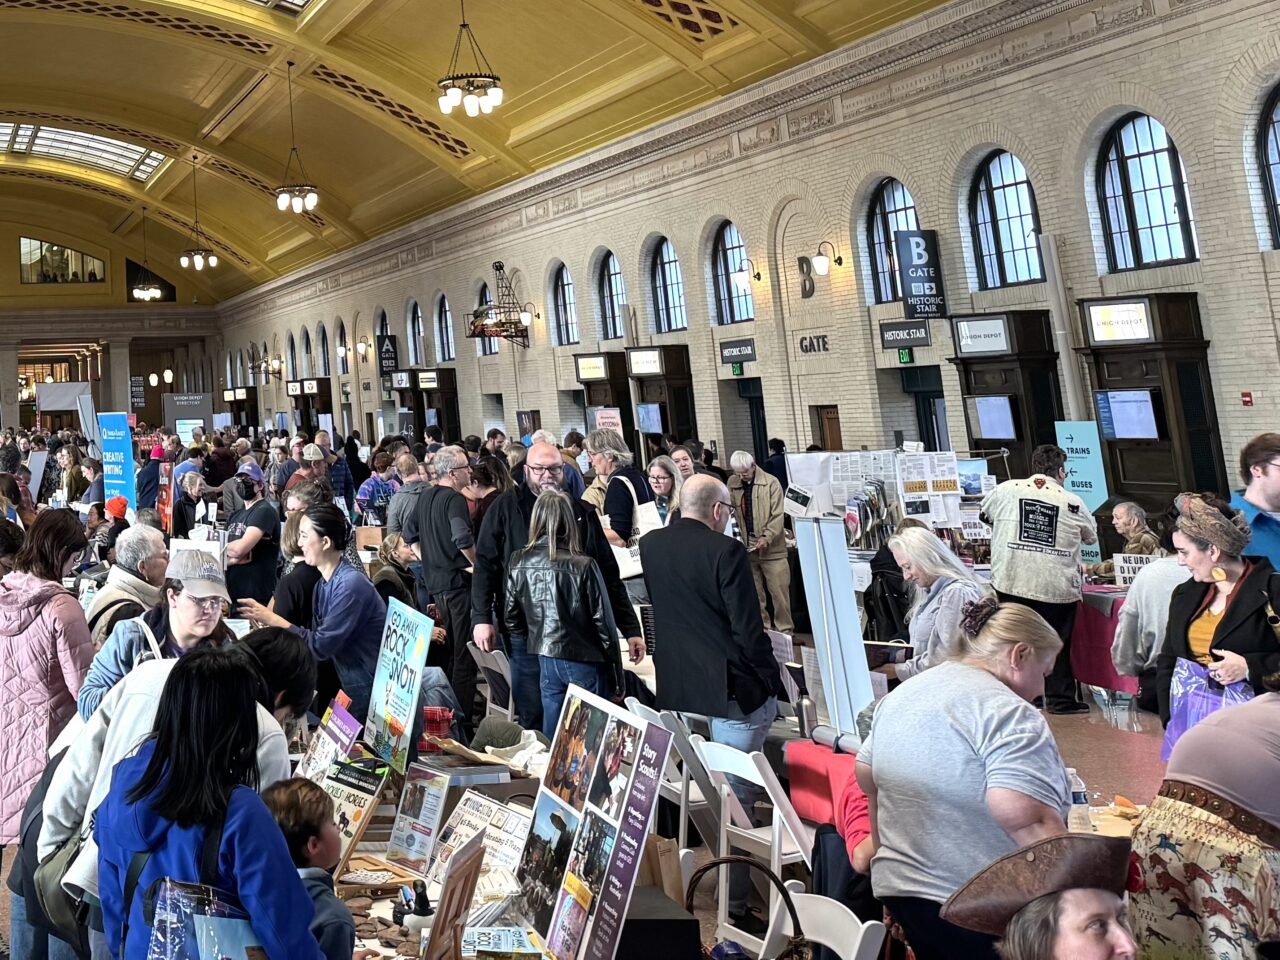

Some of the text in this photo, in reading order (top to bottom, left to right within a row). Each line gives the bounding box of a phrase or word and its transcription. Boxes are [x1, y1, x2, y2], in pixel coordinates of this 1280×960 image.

[908, 237, 929, 265] B
[797, 256, 815, 299] B
[908, 268, 935, 277] GATE
[907, 297, 943, 305] HISTORIC
[916, 304, 937, 313] STAIR
[884, 328, 926, 340] HISTORIC STAIR
[382, 338, 394, 352] A
[800, 335, 829, 353] GATE
[722, 346, 753, 357] HISTORIC STAIR
[900, 349, 910, 362] EXIT
[103, 452, 124, 462] CREATIVE
[1066, 447, 1091, 455] TRAINS
[104, 464, 123, 475] WRITING
[1071, 481, 1093, 489] BUSES
[1122, 556, 1150, 565] NEURO
[1123, 576, 1135, 585] BO
[391, 611, 419, 640] GO AWAY,
[384, 625, 409, 662] ROCK
[389, 657, 417, 695] SNOT!
[642, 743, 657, 764] Story
[638, 759, 658, 780] Scouts!
[466, 820, 479, 831] Books
[509, 840, 521, 853] Years
